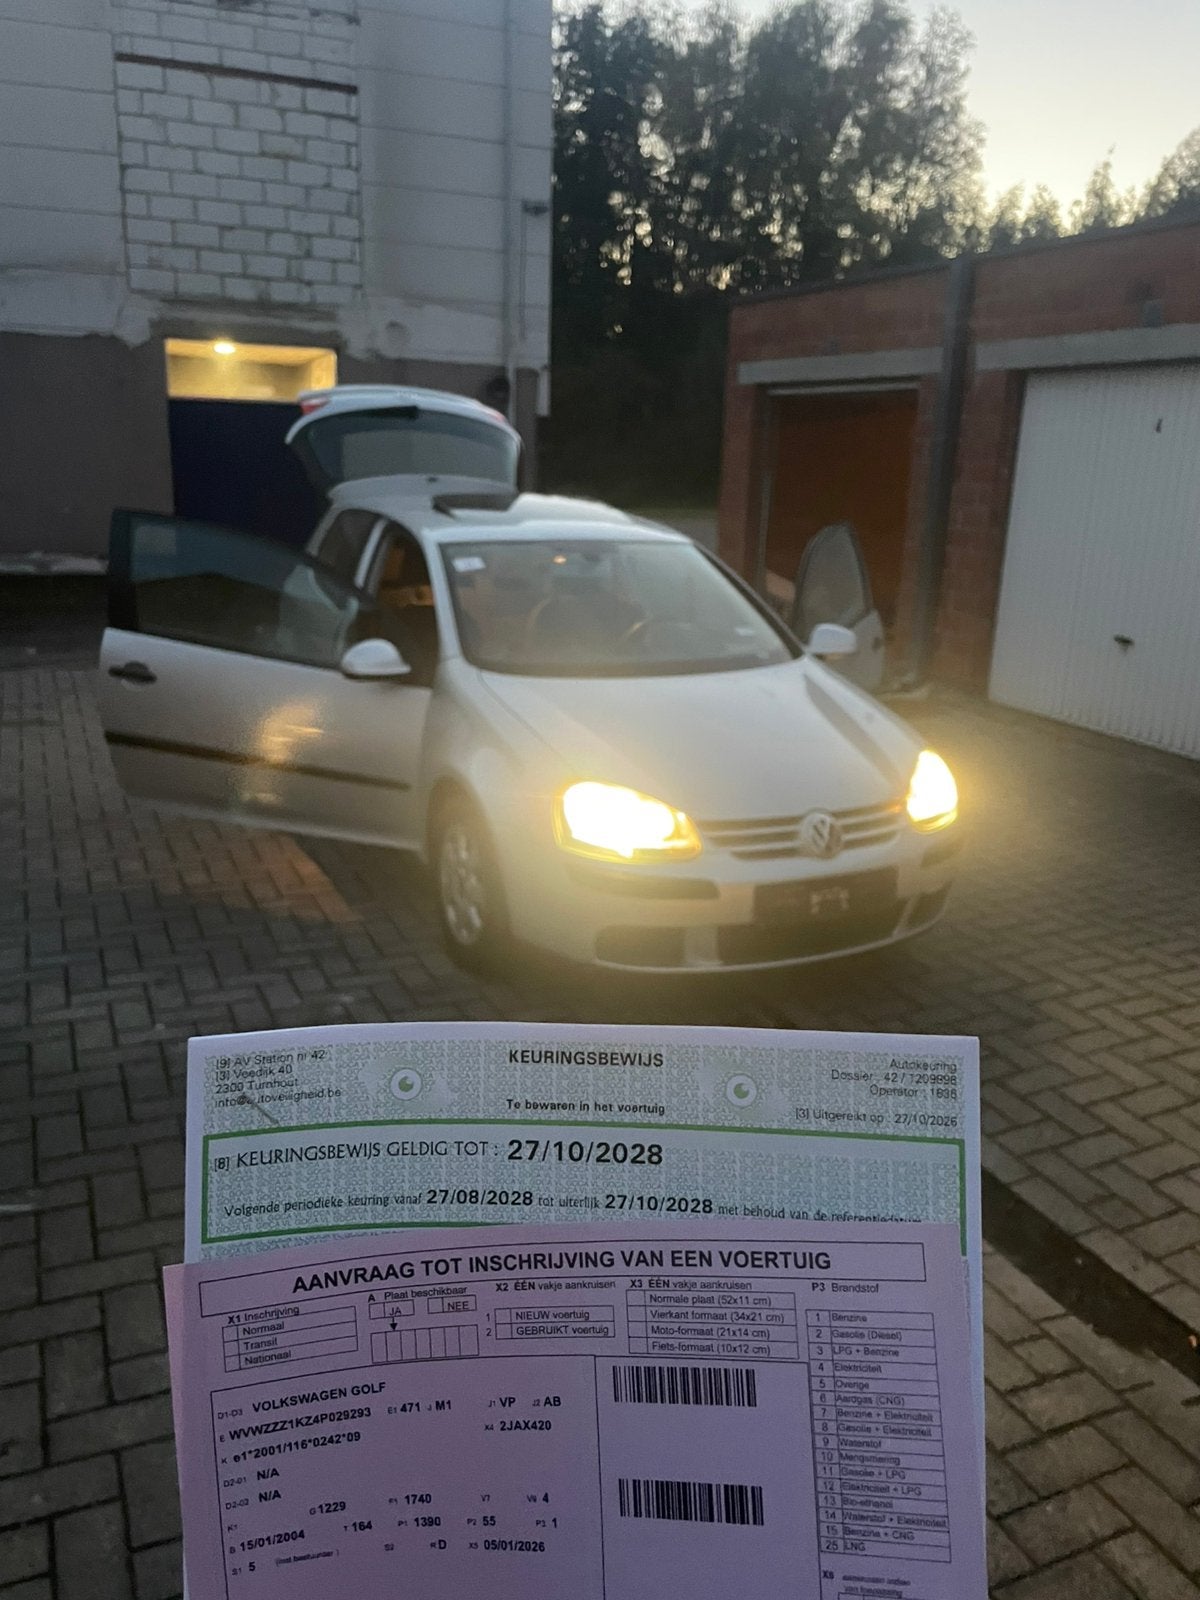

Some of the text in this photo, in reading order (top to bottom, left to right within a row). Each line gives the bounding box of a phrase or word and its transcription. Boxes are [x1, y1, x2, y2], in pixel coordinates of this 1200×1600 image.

[234, 1057, 251, 1066] AV
[254, 1054, 293, 1065] Station
[311, 1050, 325, 1060] 42
[509, 1050, 664, 1067] KEURINGSBEWIJS
[234, 1064, 293, 1079] Veedijk 40
[890, 1058, 957, 1074] Autokeuring
[831, 1069, 873, 1081] Dossier
[884, 1072, 898, 1083] 42
[215, 1079, 299, 1094] 2300 Turnhout
[869, 1084, 919, 1097] Operator
[506, 1099, 665, 1116] Te bewaren in het voertuig
[812, 1109, 866, 1122] Uitgereikt
[870, 1112, 884, 1124] op
[214, 1139, 664, 1172] [8] KEURINGSBEWIJS GELDIG TOT 27/10/2028
[224, 1201, 280, 1217] Volgende
[284, 1195, 343, 1213] periodieke
[348, 1193, 389, 1207] keuring
[394, 1192, 422, 1204] vanaf
[427, 1189, 533, 1206] 27/08/2028
[538, 1196, 554, 1207] tot
[559, 1196, 600, 1209] uiterlijk
[605, 1194, 714, 1214] 27/10/2028
[718, 1204, 738, 1216] met
[744, 1205, 785, 1219] behoud
[790, 1209, 808, 1220] van
[813, 1209, 828, 1222] de
[292, 1250, 831, 1294] AANVRAAG TOT INSCHRIJVING VAN EEN VOERTUIG
[495, 1279, 616, 1292] X2 ÉÉN vakje aankruisen
[630, 1277, 752, 1291] X3 ÉÉN vakje aankruisen
[811, 1282, 879, 1293] P3 Brandstof
[368, 1287, 467, 1303] A Plaat beschikbaar
[650, 1294, 689, 1304] Normale
[692, 1295, 715, 1306] plaat
[753, 1296, 772, 1307] cm)
[389, 1306, 402, 1316] JA
[447, 1301, 470, 1311] NEE
[228, 1306, 300, 1325] X1 Inschrijving
[515, 1310, 590, 1321] NIEUW voertuig
[650, 1310, 689, 1320] Vierkant
[691, 1310, 728, 1321] formaat
[766, 1313, 784, 1323] cm)
[832, 1313, 868, 1322] Benzine
[242, 1322, 285, 1336] Normaal
[516, 1325, 609, 1336] GEBRUIKT voertuig
[651, 1326, 714, 1337] Moto-formaat
[752, 1329, 771, 1340] cm)
[816, 1329, 822, 1338] 2
[244, 1337, 278, 1351] Transit
[245, 1350, 291, 1365] Nationaal
[832, 1346, 900, 1357] LPG Benzine
[818, 1362, 882, 1373] 4 Elektriciteit
[819, 1379, 870, 1390] 5 Overige
[252, 1382, 386, 1413] VOLKSWAGEN GOLF
[500, 1397, 516, 1407] VP
[544, 1396, 561, 1407] AB
[400, 1402, 421, 1413] 471
[435, 1400, 451, 1411] M1
[821, 1408, 827, 1417] 7
[837, 1408, 873, 1419] Benzine
[228, 1407, 371, 1441] WVWZZZ1KZ4P029293
[500, 1420, 552, 1431] 2JAX420
[257, 1468, 280, 1481] N/A
[258, 1489, 282, 1503] N/A
[404, 1493, 432, 1505] 1740
[542, 1492, 549, 1504] 4
[318, 1501, 346, 1515] 1229
[352, 1520, 373, 1532] 164
[414, 1516, 441, 1527] 1390
[482, 1516, 496, 1527] 55
[551, 1517, 557, 1528] 1
[239, 1530, 305, 1552] 15/01/2004
[438, 1539, 447, 1550] D
[484, 1539, 545, 1552] 05/01/2026
[248, 1562, 256, 1572] 5
